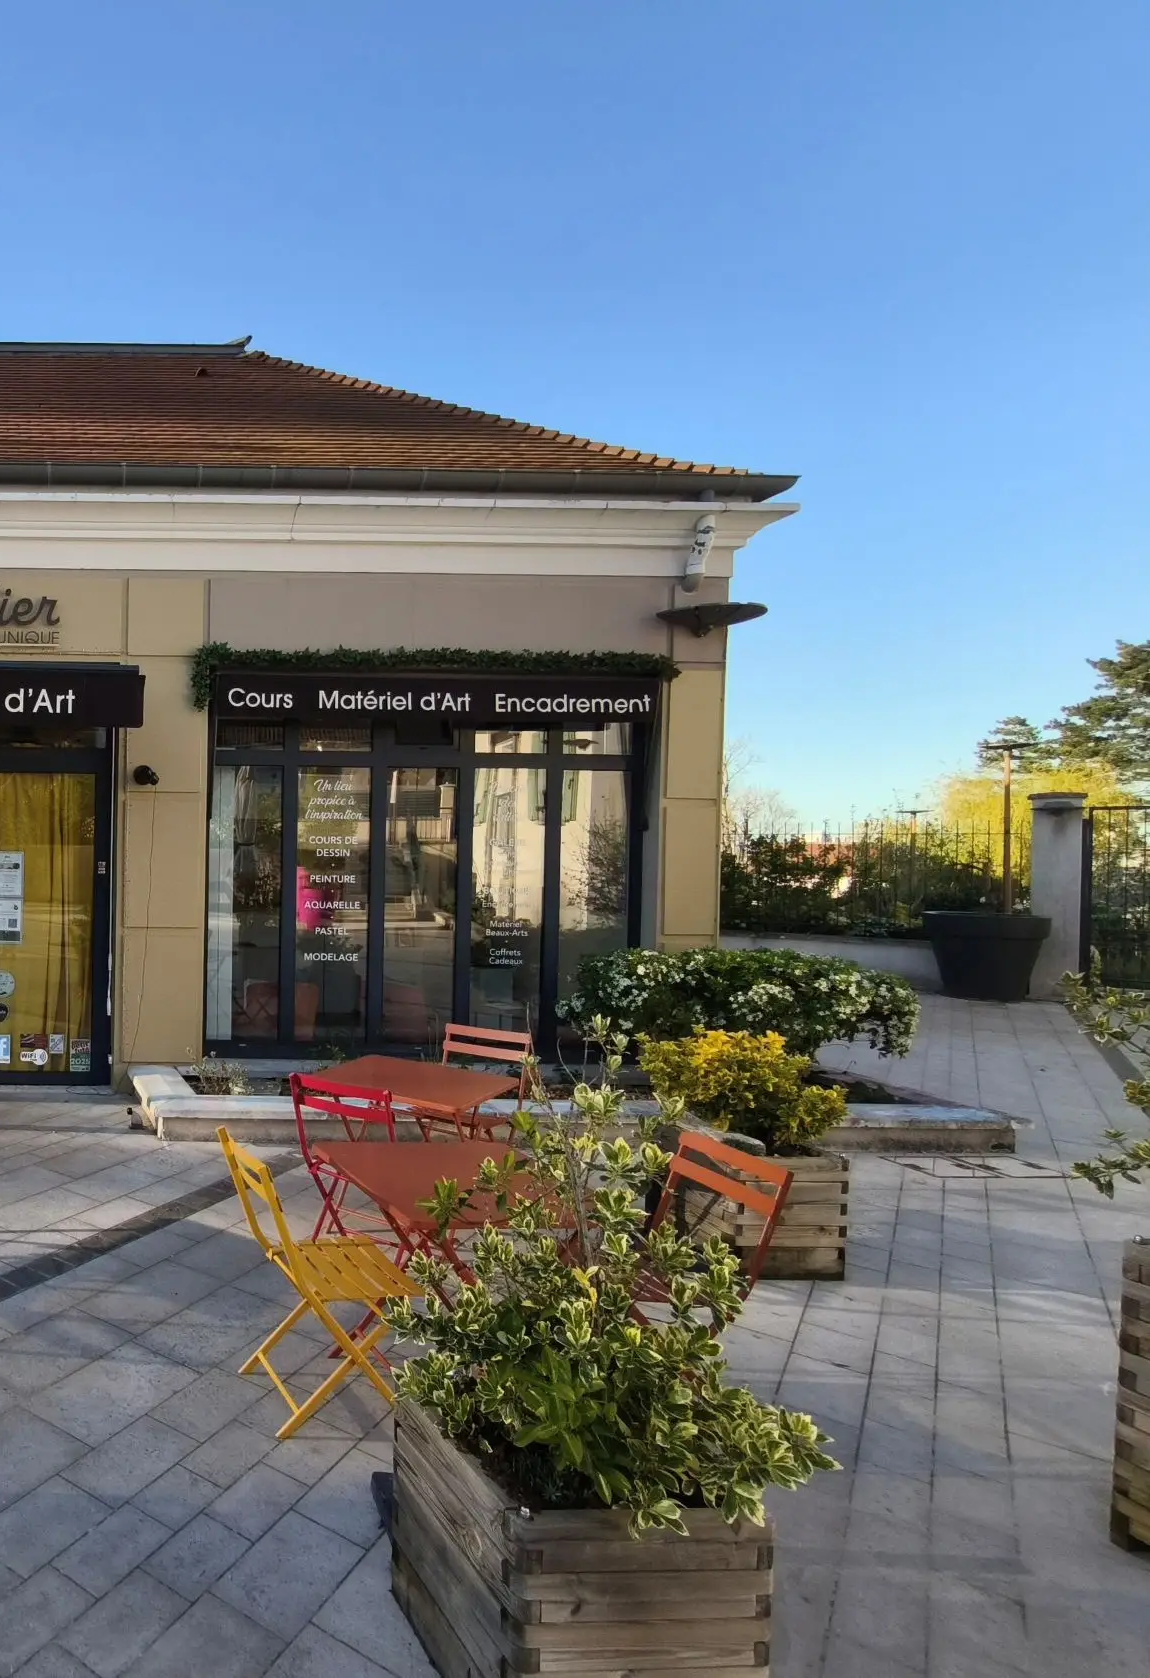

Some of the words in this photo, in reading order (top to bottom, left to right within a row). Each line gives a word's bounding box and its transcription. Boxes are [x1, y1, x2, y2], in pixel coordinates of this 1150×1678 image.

[4, 687, 76, 714] d'Art
[228, 687, 293, 709] Cours
[318, 690, 412, 711] Matériel
[420, 692, 471, 712] d'Art
[495, 693, 651, 713] Encadrement
[313, 779, 332, 792] Un
[333, 780, 353, 791] lieu
[308, 794, 347, 808] propice
[348, 795, 356, 806] à
[305, 808, 364, 822] l'inspiration
[309, 835, 342, 845] COURS
[344, 836, 359, 845] DE
[316, 848, 351, 857] DESSIN
[310, 874, 356, 883] PEINTURE
[304, 900, 361, 910] AQUARELLE
[315, 926, 350, 936] PASTEL
[485, 928, 529, 937] Beaux-Arts
[303, 952, 359, 962] MODELAGE
[489, 948, 522, 957] Coffrets
[488, 956, 523, 965] Cadeaux
